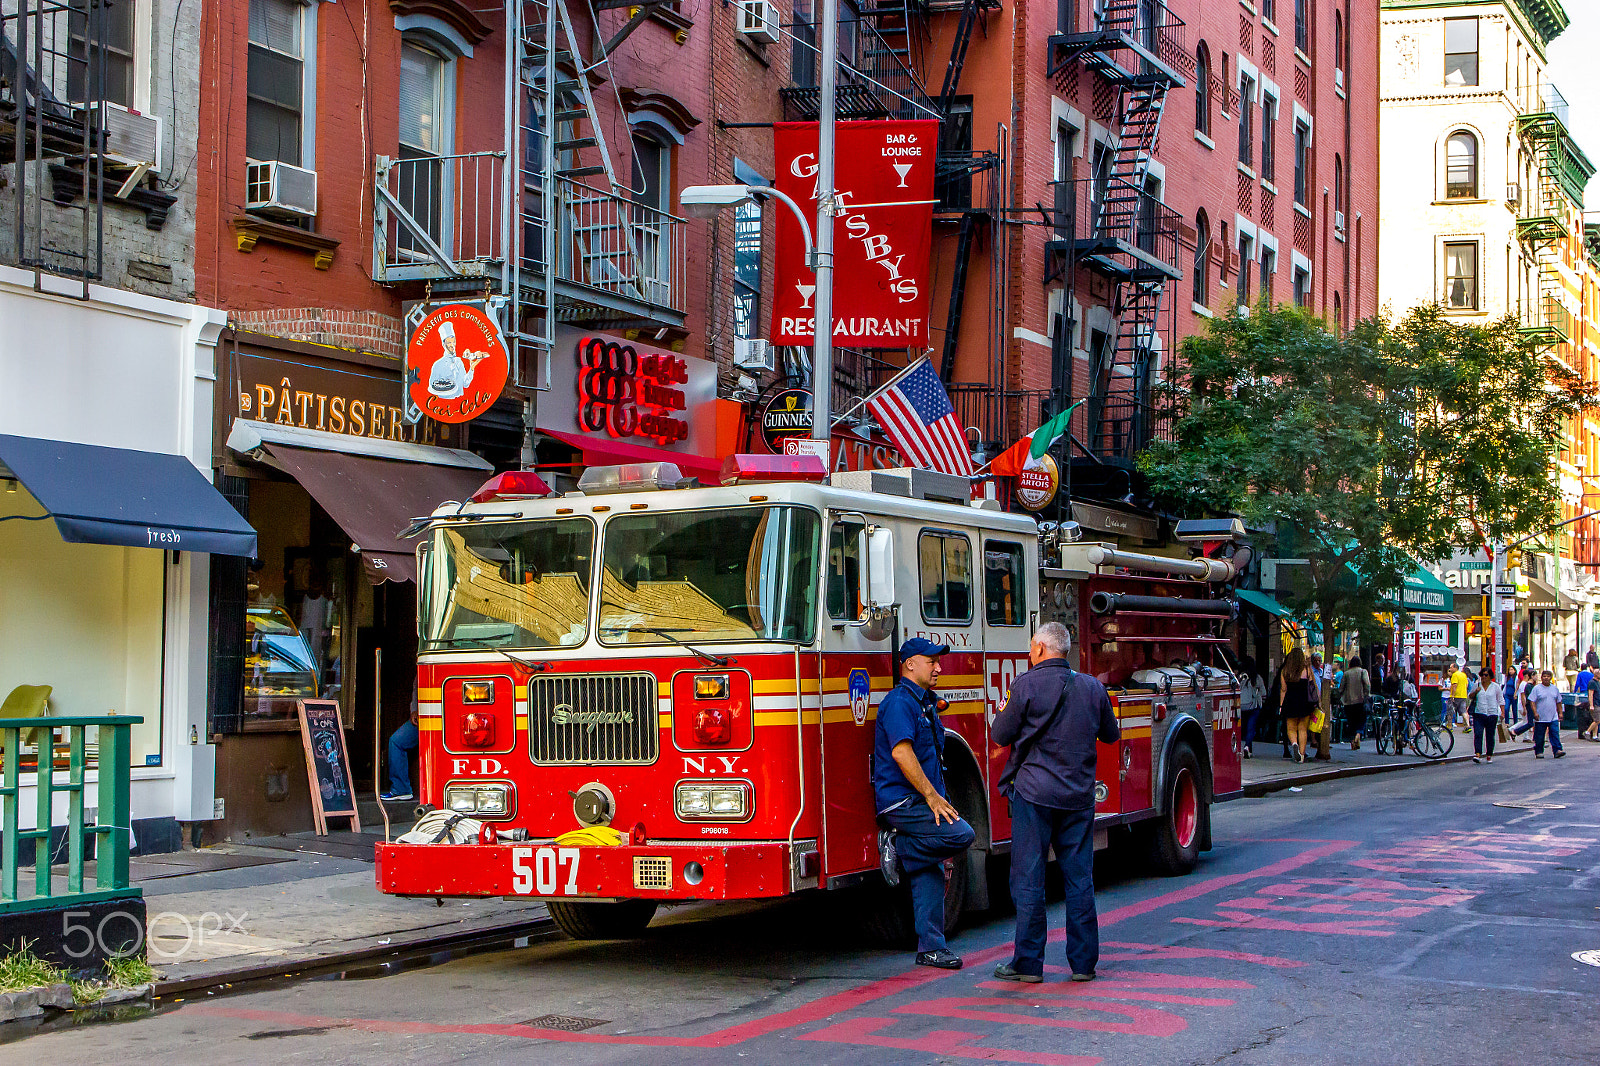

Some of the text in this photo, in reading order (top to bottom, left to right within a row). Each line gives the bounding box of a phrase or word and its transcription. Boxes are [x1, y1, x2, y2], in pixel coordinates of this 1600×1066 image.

[886, 134, 918, 144] BAR &
[881, 147, 922, 156] LOUNGE
[444, 310, 458, 318] DES
[781, 317, 921, 337] RESAURANT
[764, 412, 812, 428] GUINNES
[1021, 472, 1050, 481] STELLA
[1020, 480, 1050, 489] ARTOIS
[147, 527, 181, 545] fresh
[372, 558, 388, 569] 55
[551, 703, 635, 734] Seagrave
[451, 756, 749, 775] F.D. N.Y.
[512, 847, 580, 895] 507
